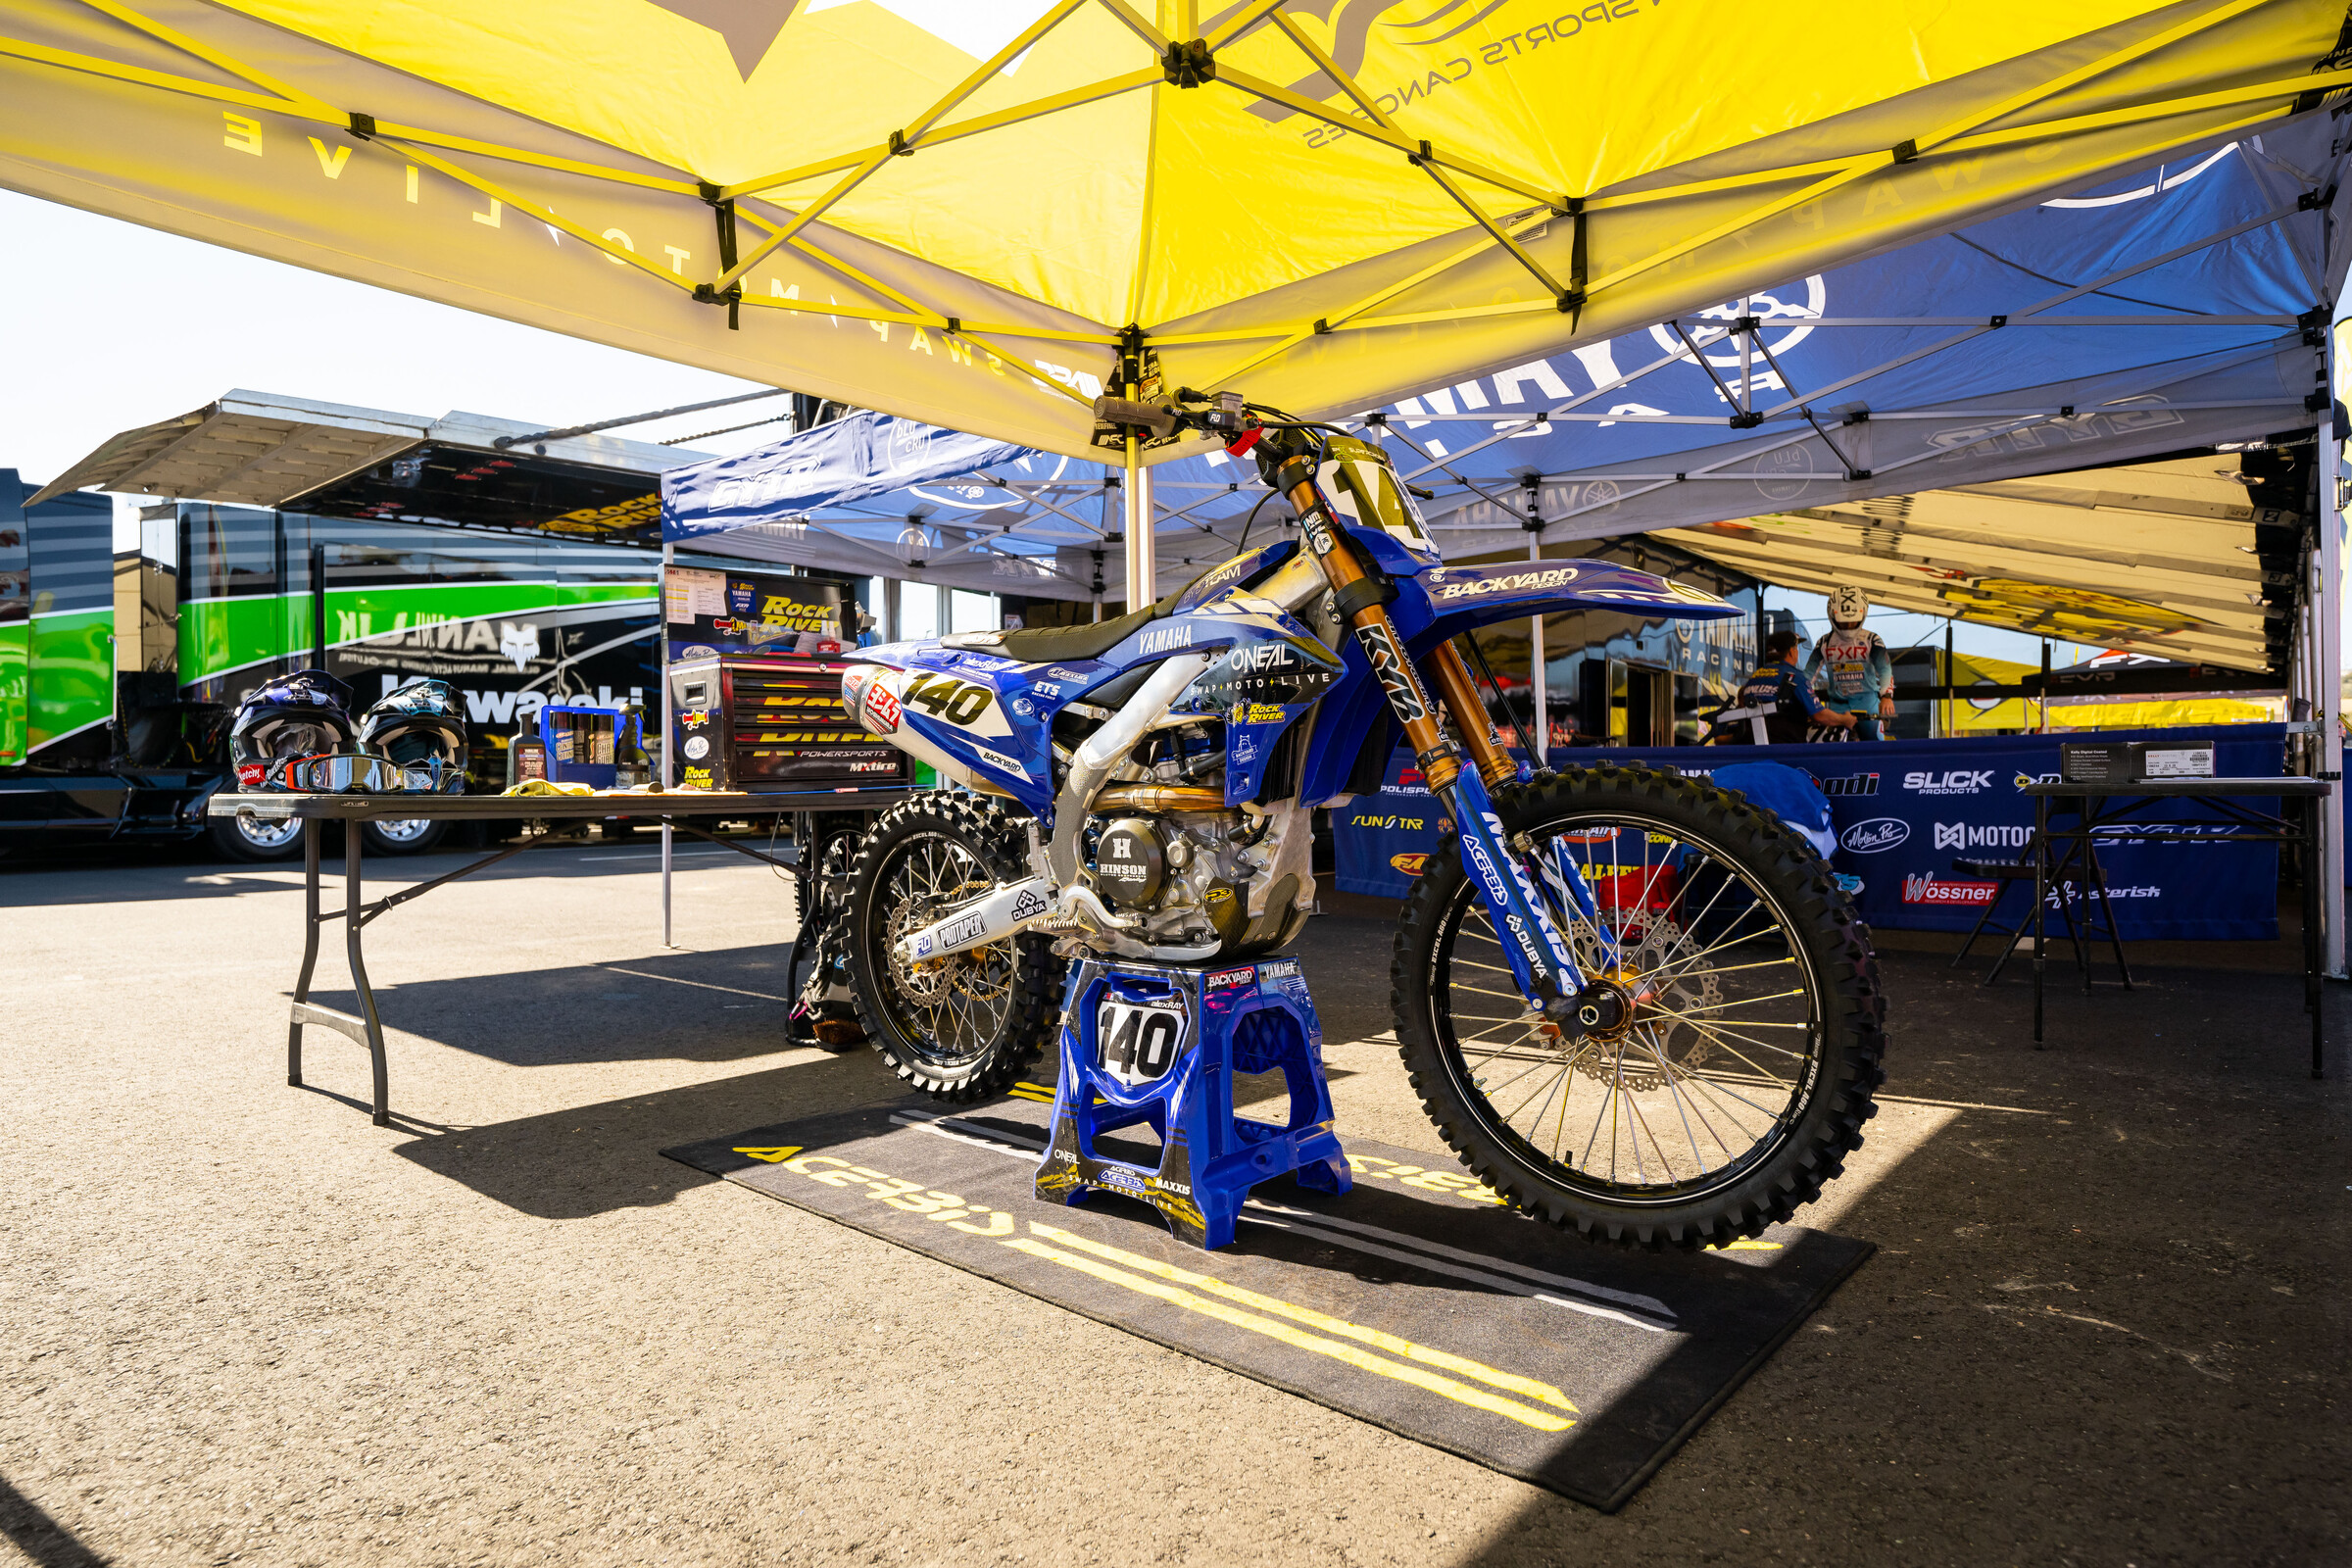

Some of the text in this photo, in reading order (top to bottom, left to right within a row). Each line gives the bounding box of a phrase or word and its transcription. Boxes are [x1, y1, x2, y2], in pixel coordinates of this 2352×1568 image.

[1210, 413, 1221, 422] FLO
[594, 504, 662, 530] RIV
[1203, 564, 1241, 588] TEAM
[1442, 567, 1579, 600] BACKYARD
[1531, 578, 1570, 590] DESIGN
[761, 595, 833, 619] ROCK
[1139, 624, 1193, 655] YAMAHA
[1230, 643, 1295, 673] O'NEAL
[1682, 648, 1755, 673] RACING
[1826, 646, 1868, 662] FXR
[1189, 672, 1331, 696] SWAP MOTO LIVE
[1355, 622, 1426, 724] KYB
[901, 671, 995, 726] 140
[1033, 681, 1061, 697] ETS
[1248, 711, 1286, 723] RIVER
[1250, 703, 1284, 714] ROCK
[684, 766, 710, 779] ROCK
[983, 752, 1021, 771] BACKYARD
[1380, 785, 1432, 795] POLISPO
[1902, 770, 1995, 790] SLICK
[1112, 837, 1132, 858] H
[1847, 825, 1881, 848] Motion
[1100, 863, 1147, 875] HINSON
[1905, 870, 1995, 902] Wössner
[1012, 901, 1047, 921] DUBYA
[939, 916, 983, 948] PROTAPER
[1430, 938, 1444, 966] EXCEL
[1517, 930, 1549, 980] DUBYA
[1207, 969, 1253, 988] BACKYARD
[1263, 961, 1296, 979] YAMAHA
[1151, 1000, 1185, 1010] alexRAY
[1098, 1004, 1178, 1079] 140
[1803, 1058, 1820, 1093] EXCEL
[1797, 1092, 1811, 1111] A60
[1068, 1174, 1173, 1211] SWAP MOTO LIVE
[1154, 1179, 1192, 1196] MAXXIS
